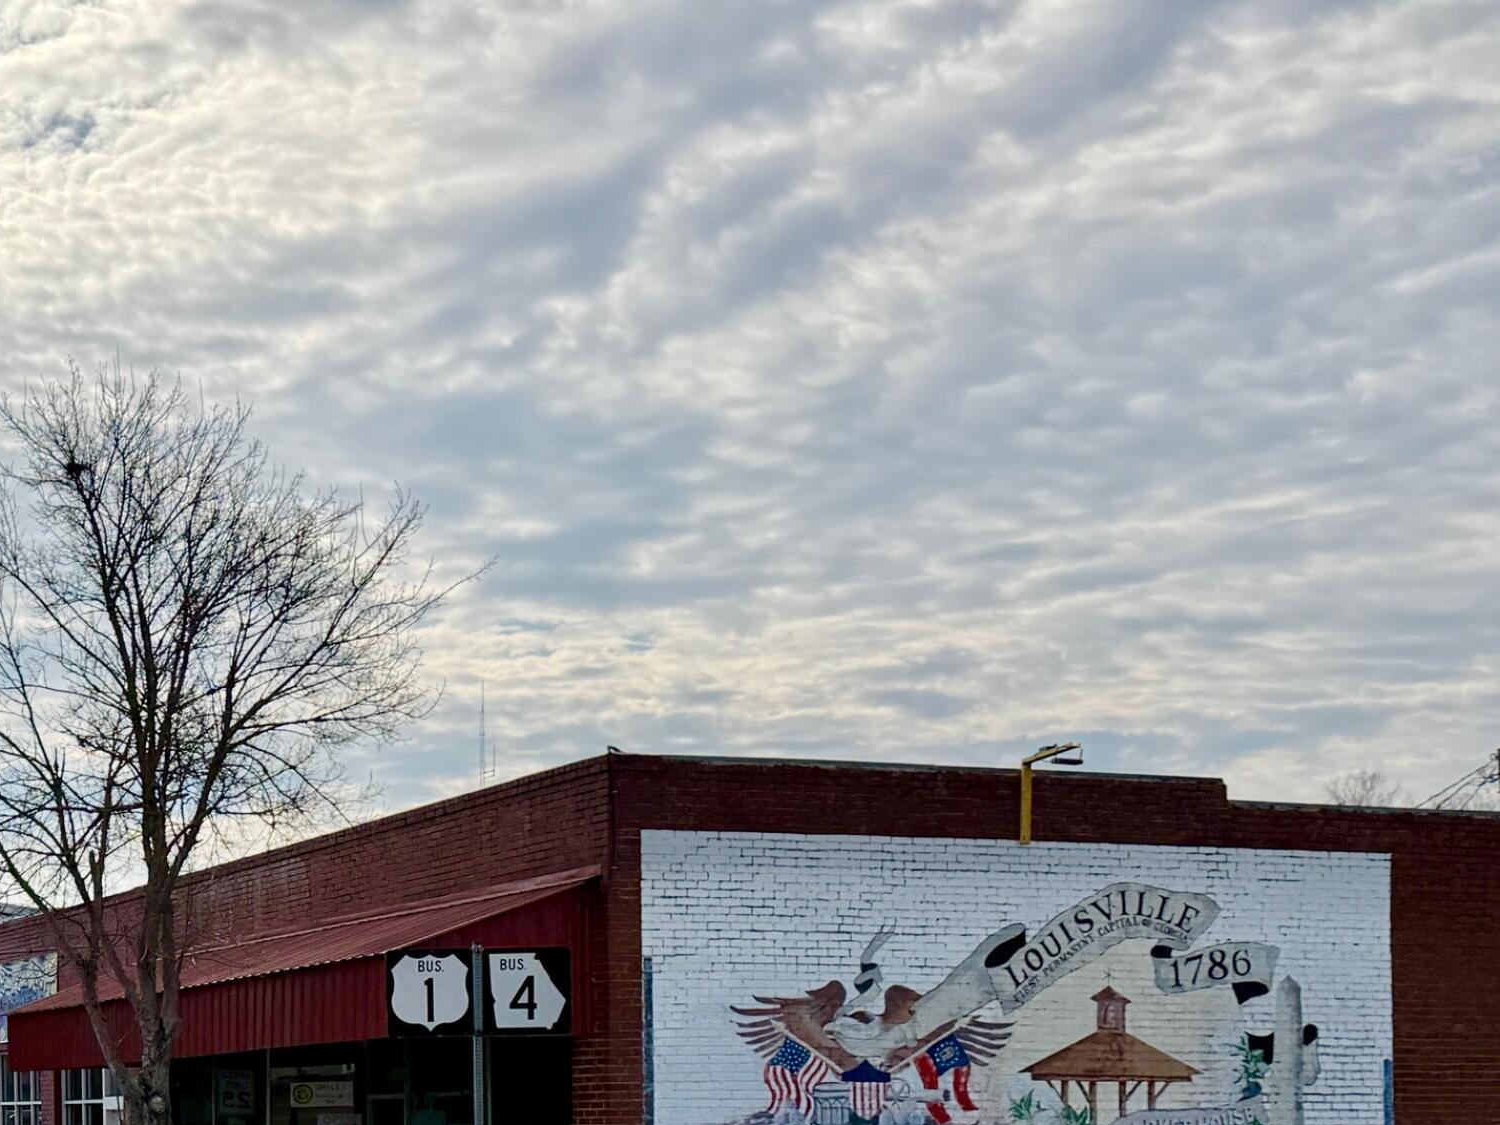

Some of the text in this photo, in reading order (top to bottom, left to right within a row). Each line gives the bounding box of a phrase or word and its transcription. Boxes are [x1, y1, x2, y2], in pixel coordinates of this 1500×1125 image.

[1003, 890, 1200, 989] LOUISVILLE
[1014, 975, 1040, 1003] FIRST
[1098, 917, 1139, 936] CAPITAL
[418, 960, 444, 973] BUS.
[500, 958, 527, 971] BUS.
[1170, 949, 1252, 988] 1786
[423, 977, 435, 1022] 1
[509, 975, 537, 1020] 4
